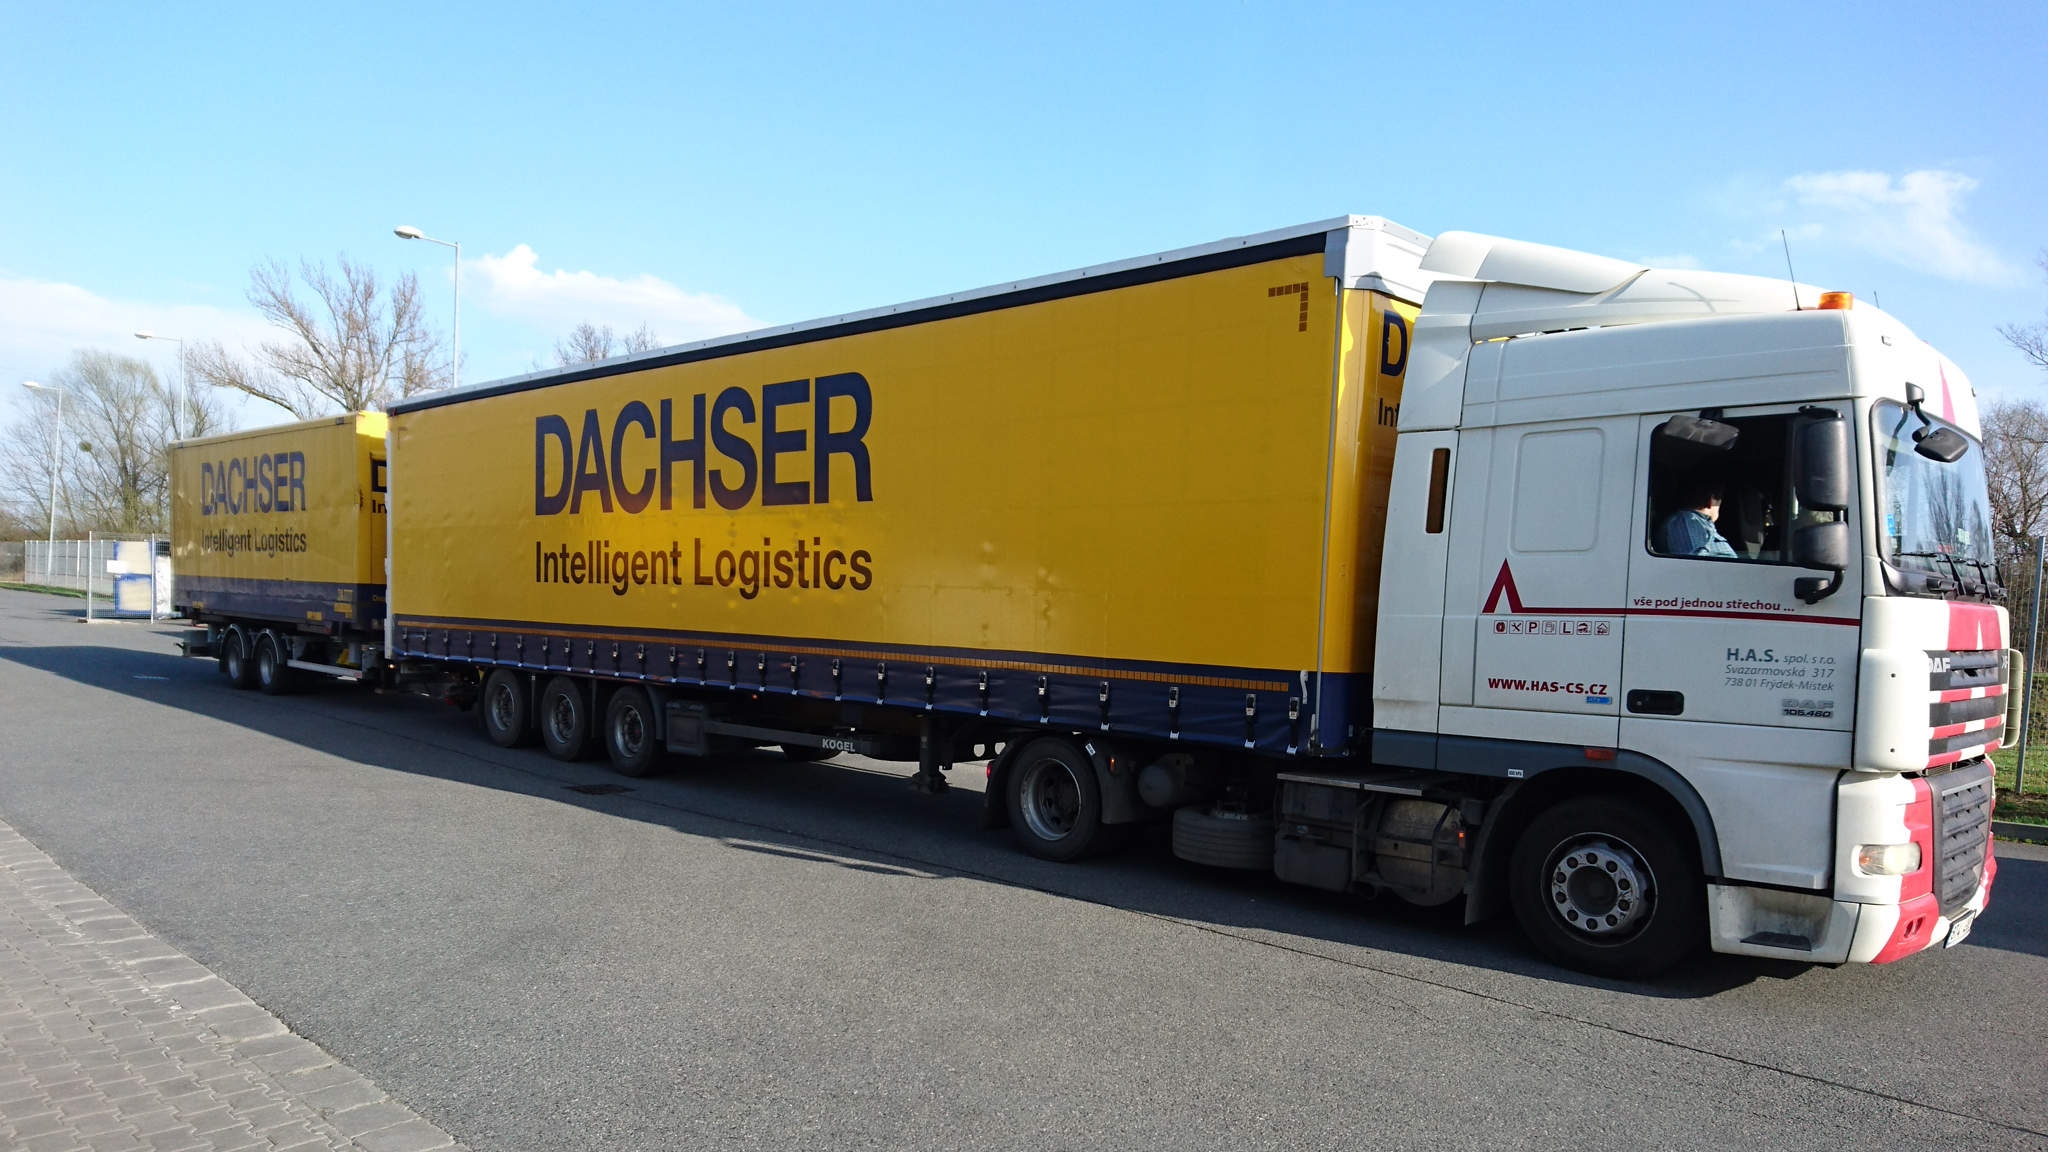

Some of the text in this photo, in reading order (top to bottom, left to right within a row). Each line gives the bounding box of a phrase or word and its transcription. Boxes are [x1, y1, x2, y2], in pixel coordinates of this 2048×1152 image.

[535, 371, 874, 517] DACHSER
[201, 451, 307, 516] DACHSER
[201, 527, 307, 558] Intelligent Logistics
[535, 536, 873, 600] Intelligent Logistics
[1633, 596, 1652, 607] vše
[1655, 597, 1678, 610] pod
[1680, 598, 1723, 610] jednou
[1726, 599, 1780, 611] střechou
[1726, 648, 1779, 663] H.A.S.
[1783, 654, 1809, 665] spol.
[1725, 664, 1835, 678] Svazarmovská 317
[1724, 677, 1835, 691] 738 01 Frýdek-Místek
